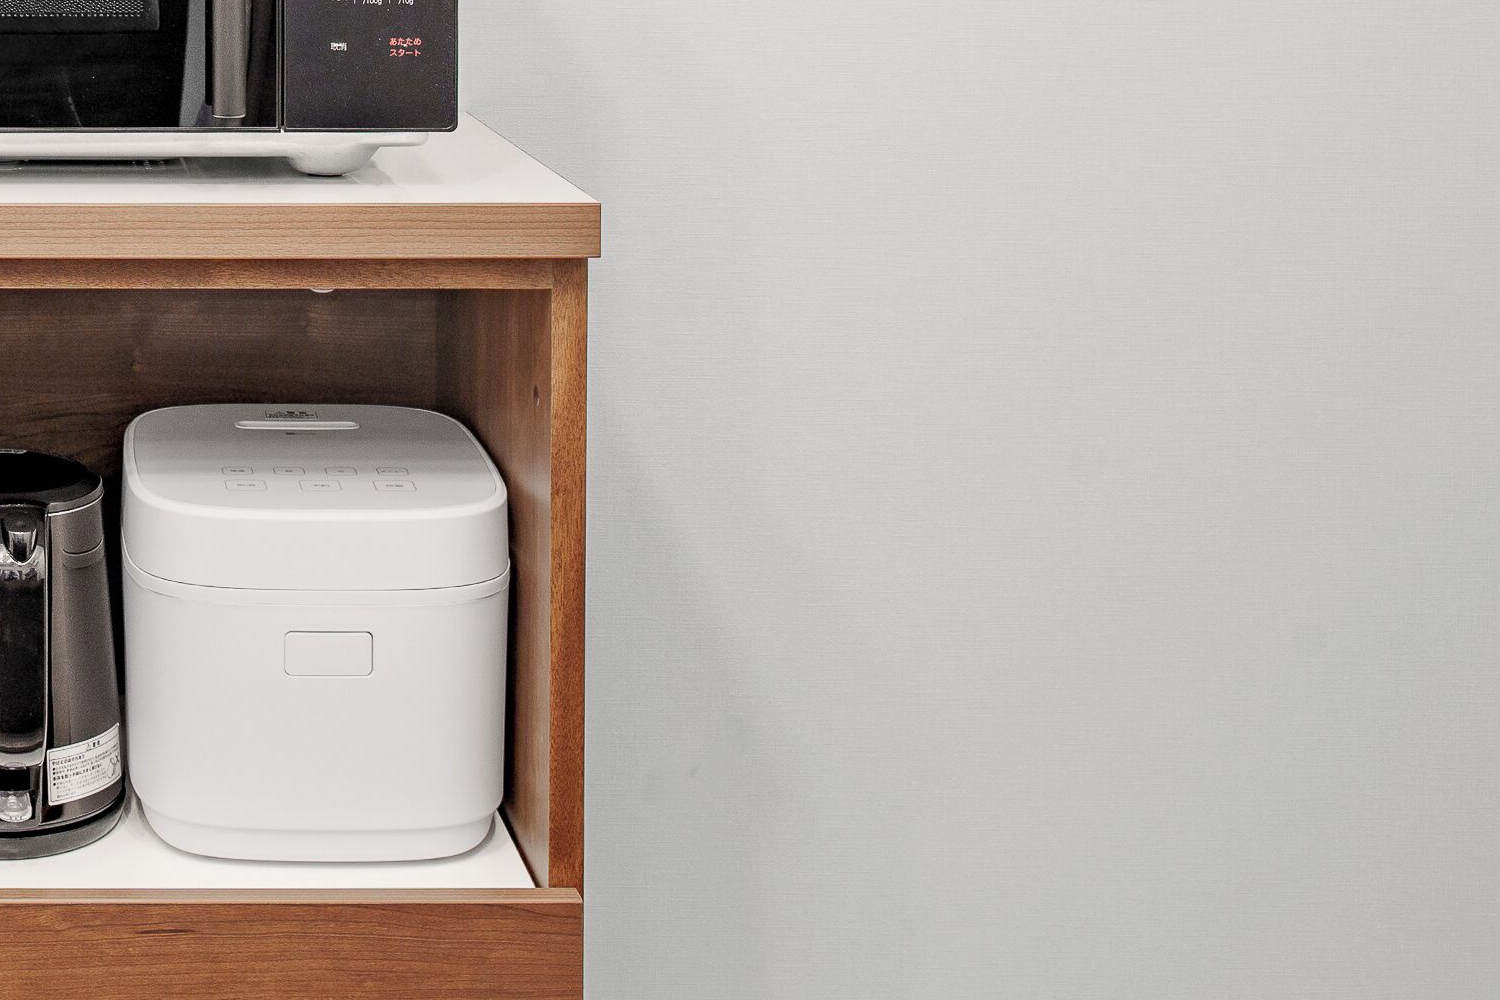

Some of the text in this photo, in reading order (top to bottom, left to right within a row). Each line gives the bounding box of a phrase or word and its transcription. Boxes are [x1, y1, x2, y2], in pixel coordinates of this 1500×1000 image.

[389, 37, 422, 46] あたため
[389, 49, 421, 57] スタート
